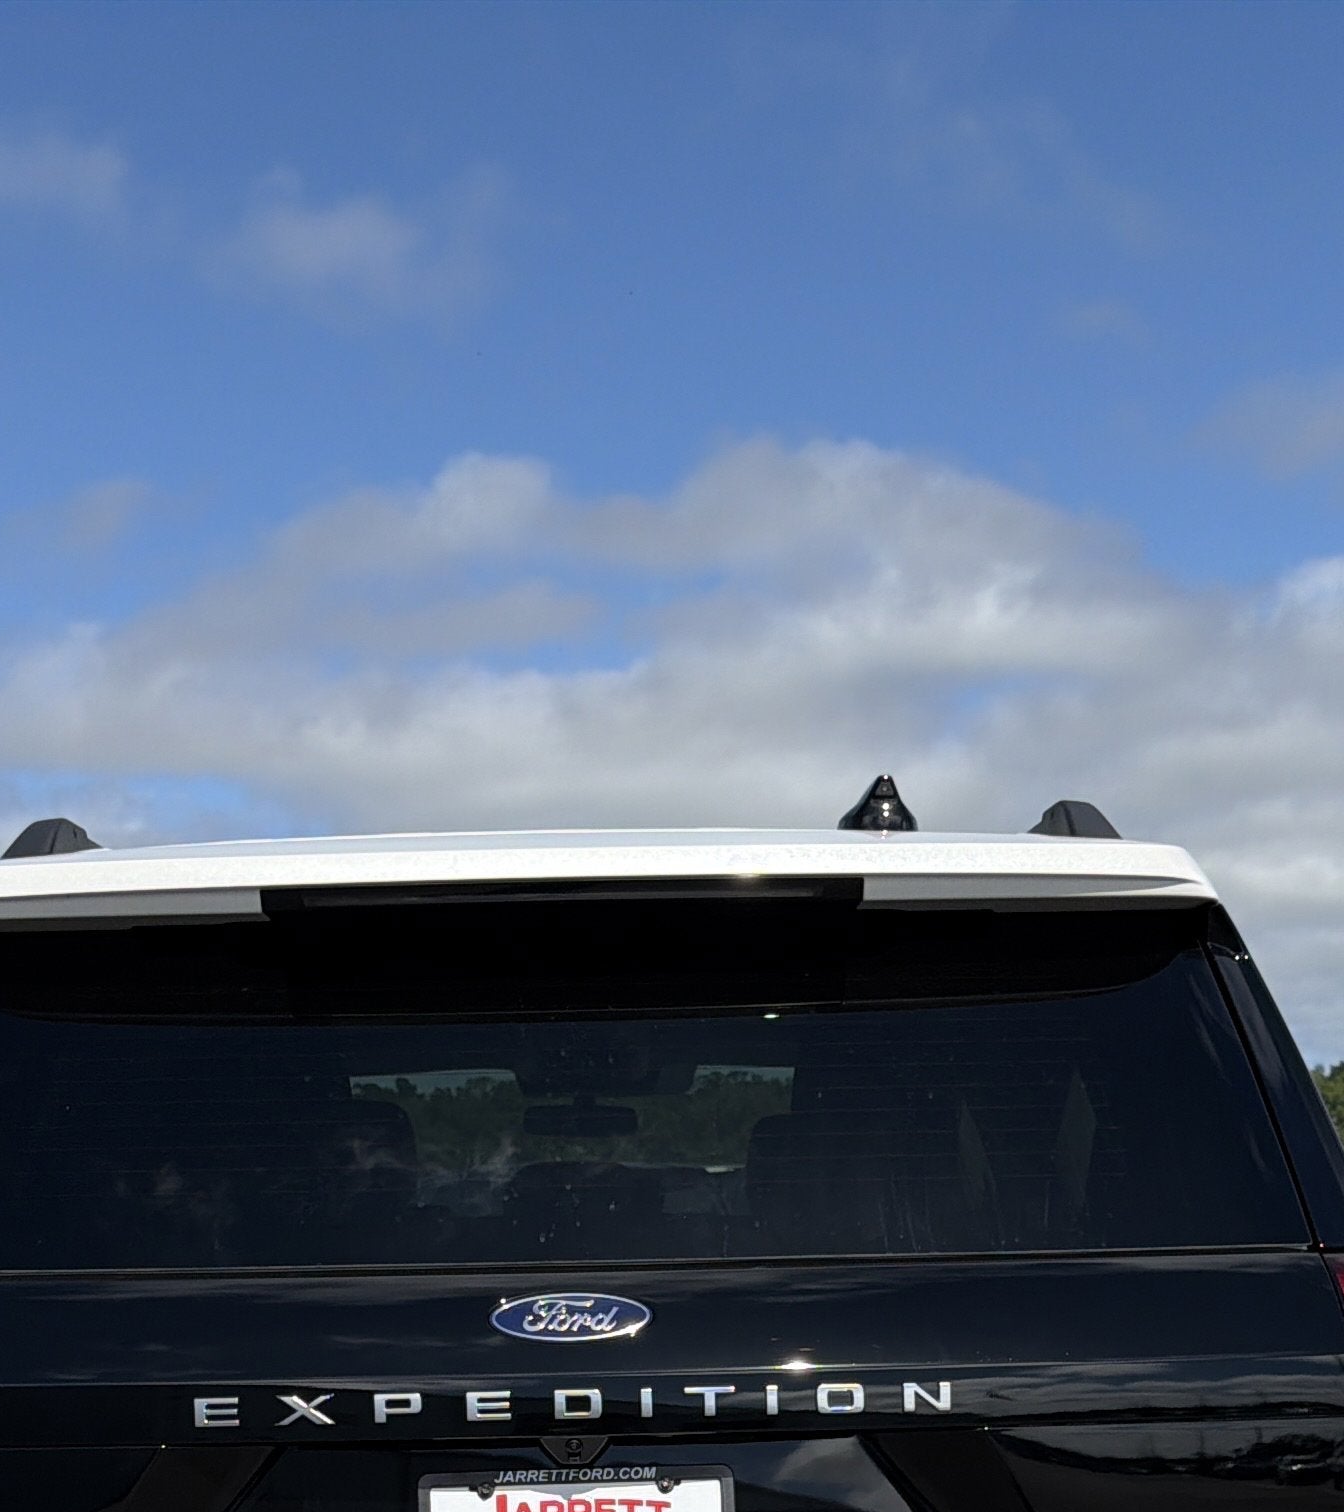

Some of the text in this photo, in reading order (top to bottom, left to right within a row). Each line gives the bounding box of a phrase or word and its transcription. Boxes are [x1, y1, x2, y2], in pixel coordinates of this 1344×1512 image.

[522, 1299, 619, 1332] Ford
[193, 1381, 953, 1428] EXPEDITION
[493, 1466, 657, 1484] JARRETTFORD.COM
